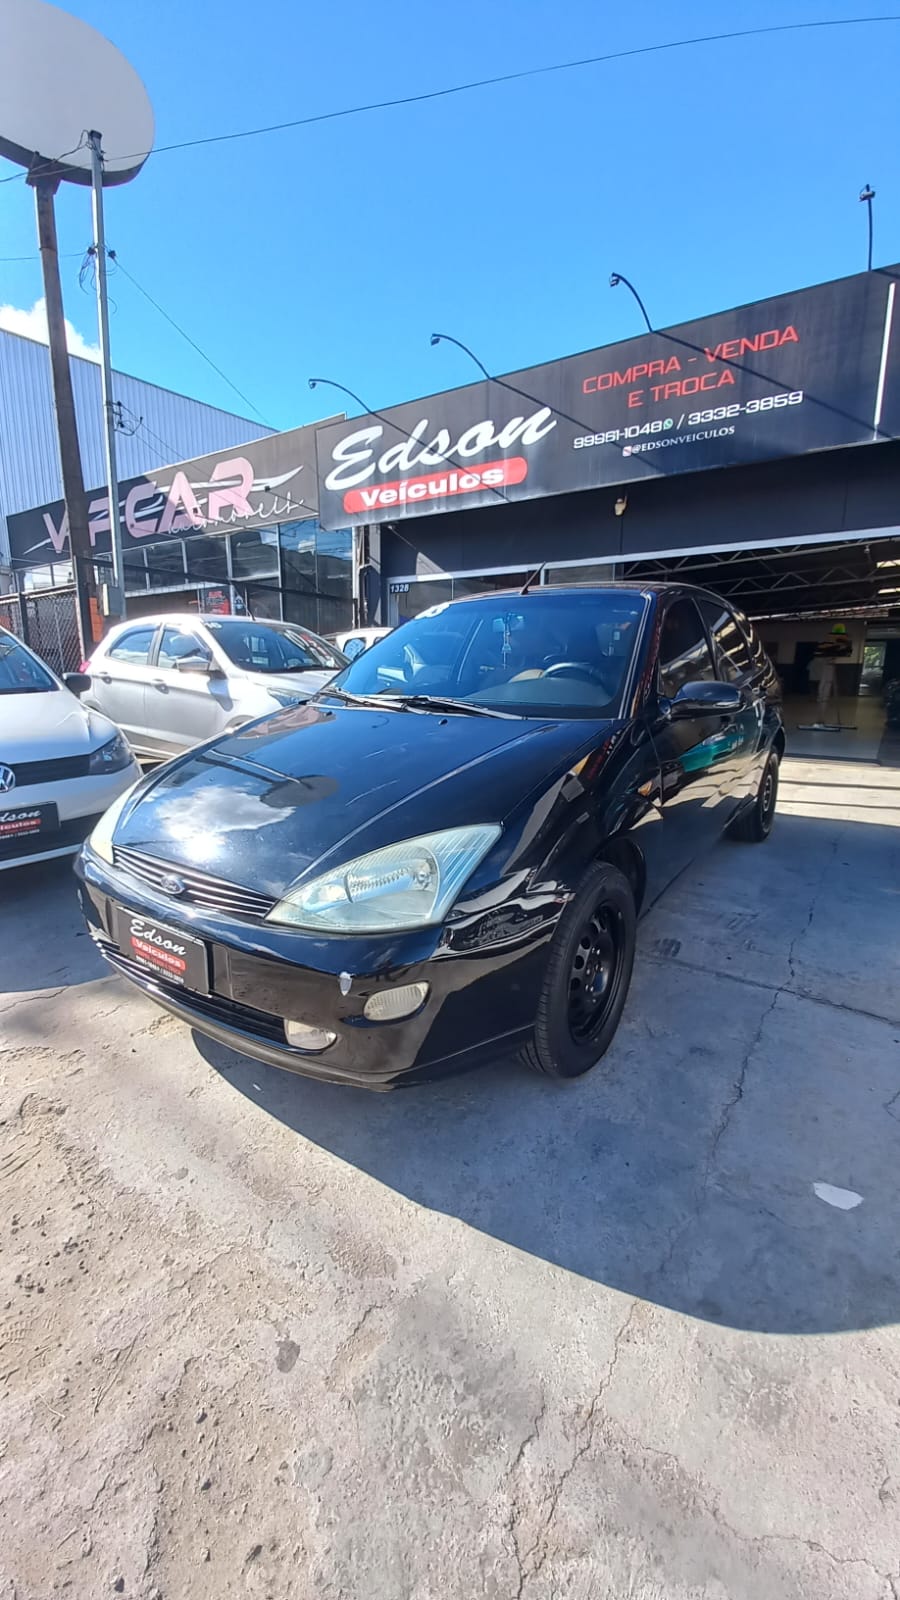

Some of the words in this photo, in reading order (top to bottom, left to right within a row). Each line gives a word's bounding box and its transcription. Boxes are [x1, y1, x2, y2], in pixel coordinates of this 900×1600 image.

[582, 356, 681, 394] COMPRA
[704, 325, 799, 363] VENDA
[627, 390, 644, 409] E
[651, 369, 735, 402] TROCA
[687, 390, 804, 426] 3332-3859
[325, 406, 558, 491] Edson
[359, 467, 505, 507] Veículos
[129, 919, 186, 955] Edson
